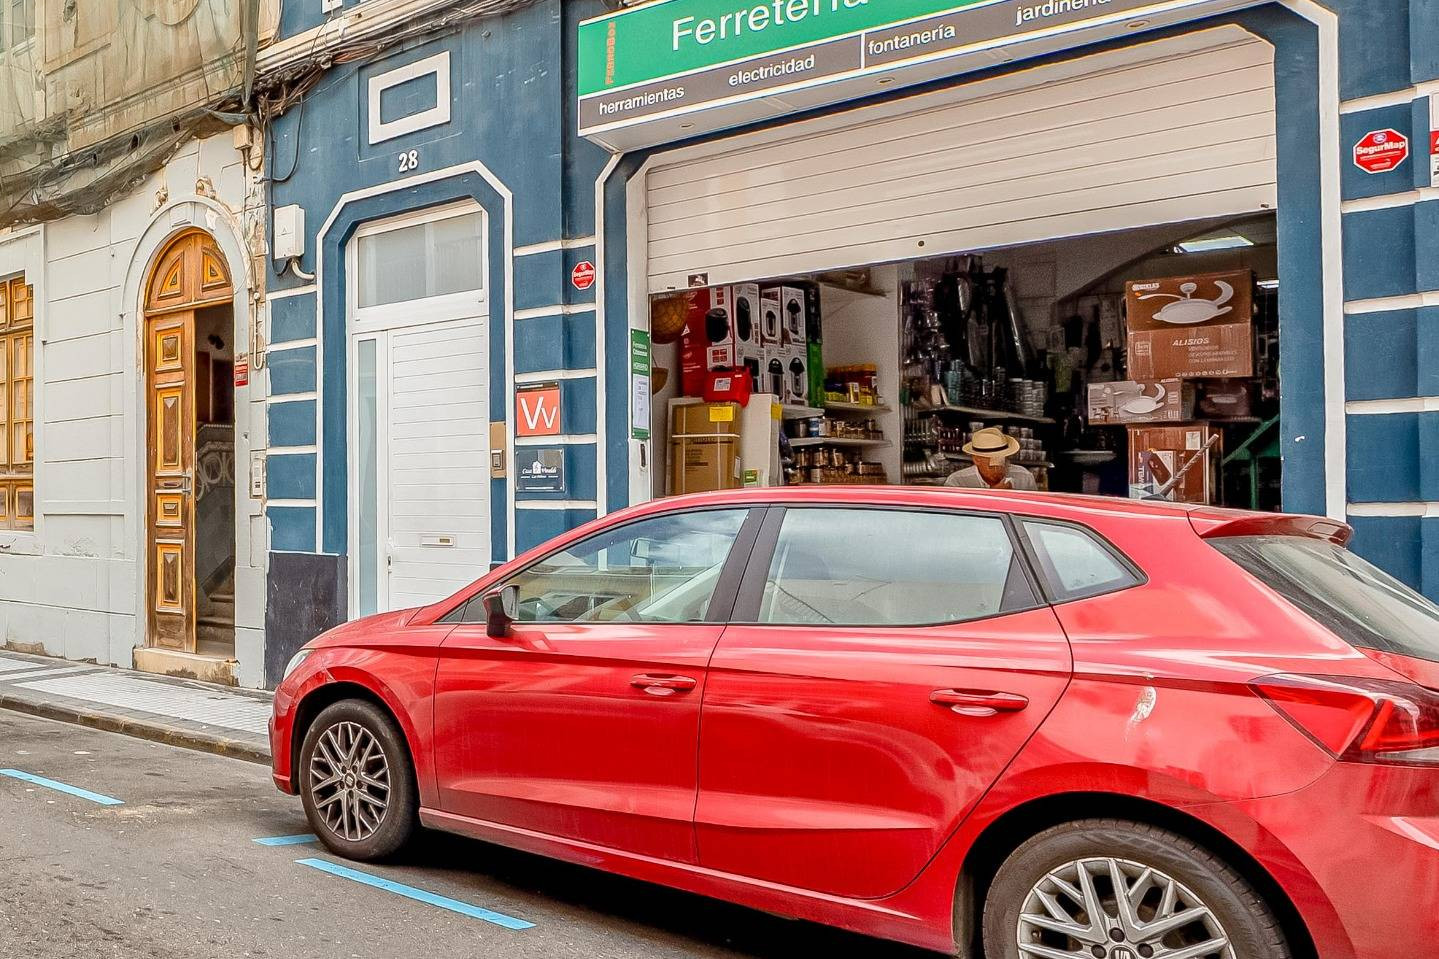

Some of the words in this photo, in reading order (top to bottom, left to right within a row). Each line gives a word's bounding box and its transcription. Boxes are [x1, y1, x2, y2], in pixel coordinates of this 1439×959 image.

[866, 23, 956, 55] fontanería
[728, 54, 816, 87] electricidad
[599, 86, 685, 116] herramientas
[398, 149, 418, 173] 28
[1356, 142, 1406, 155] SegurMap
[1171, 337, 1211, 346] ALISIOS
